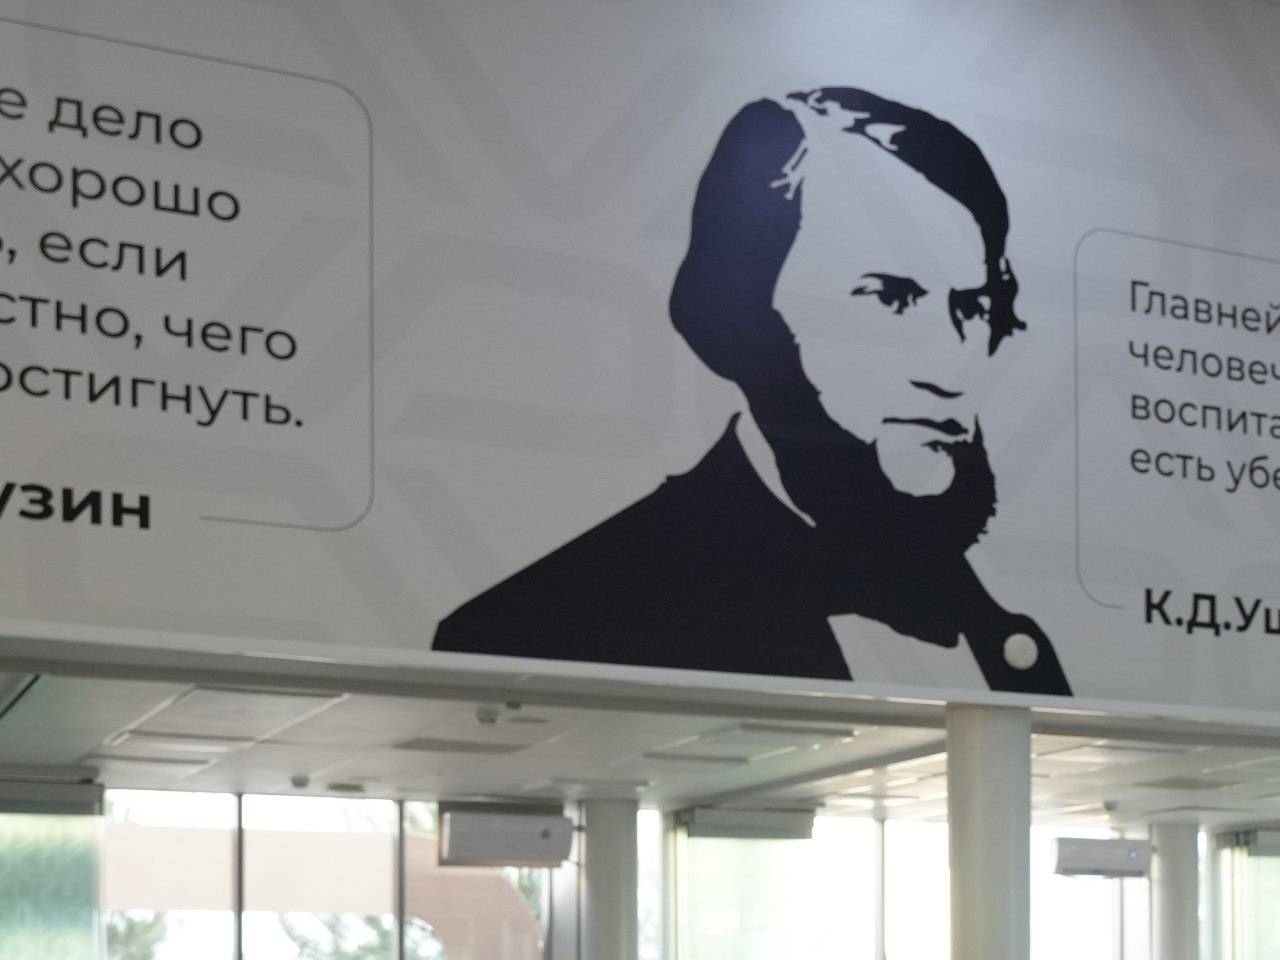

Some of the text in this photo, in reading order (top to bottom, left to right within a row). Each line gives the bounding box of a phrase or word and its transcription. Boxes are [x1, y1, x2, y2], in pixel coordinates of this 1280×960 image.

[48, 97, 202, 149] дело
[0, 156, 240, 221] хорошо
[39, 232, 186, 281] если
[164, 315, 297, 360] чего
[1130, 449, 1215, 482] есть
